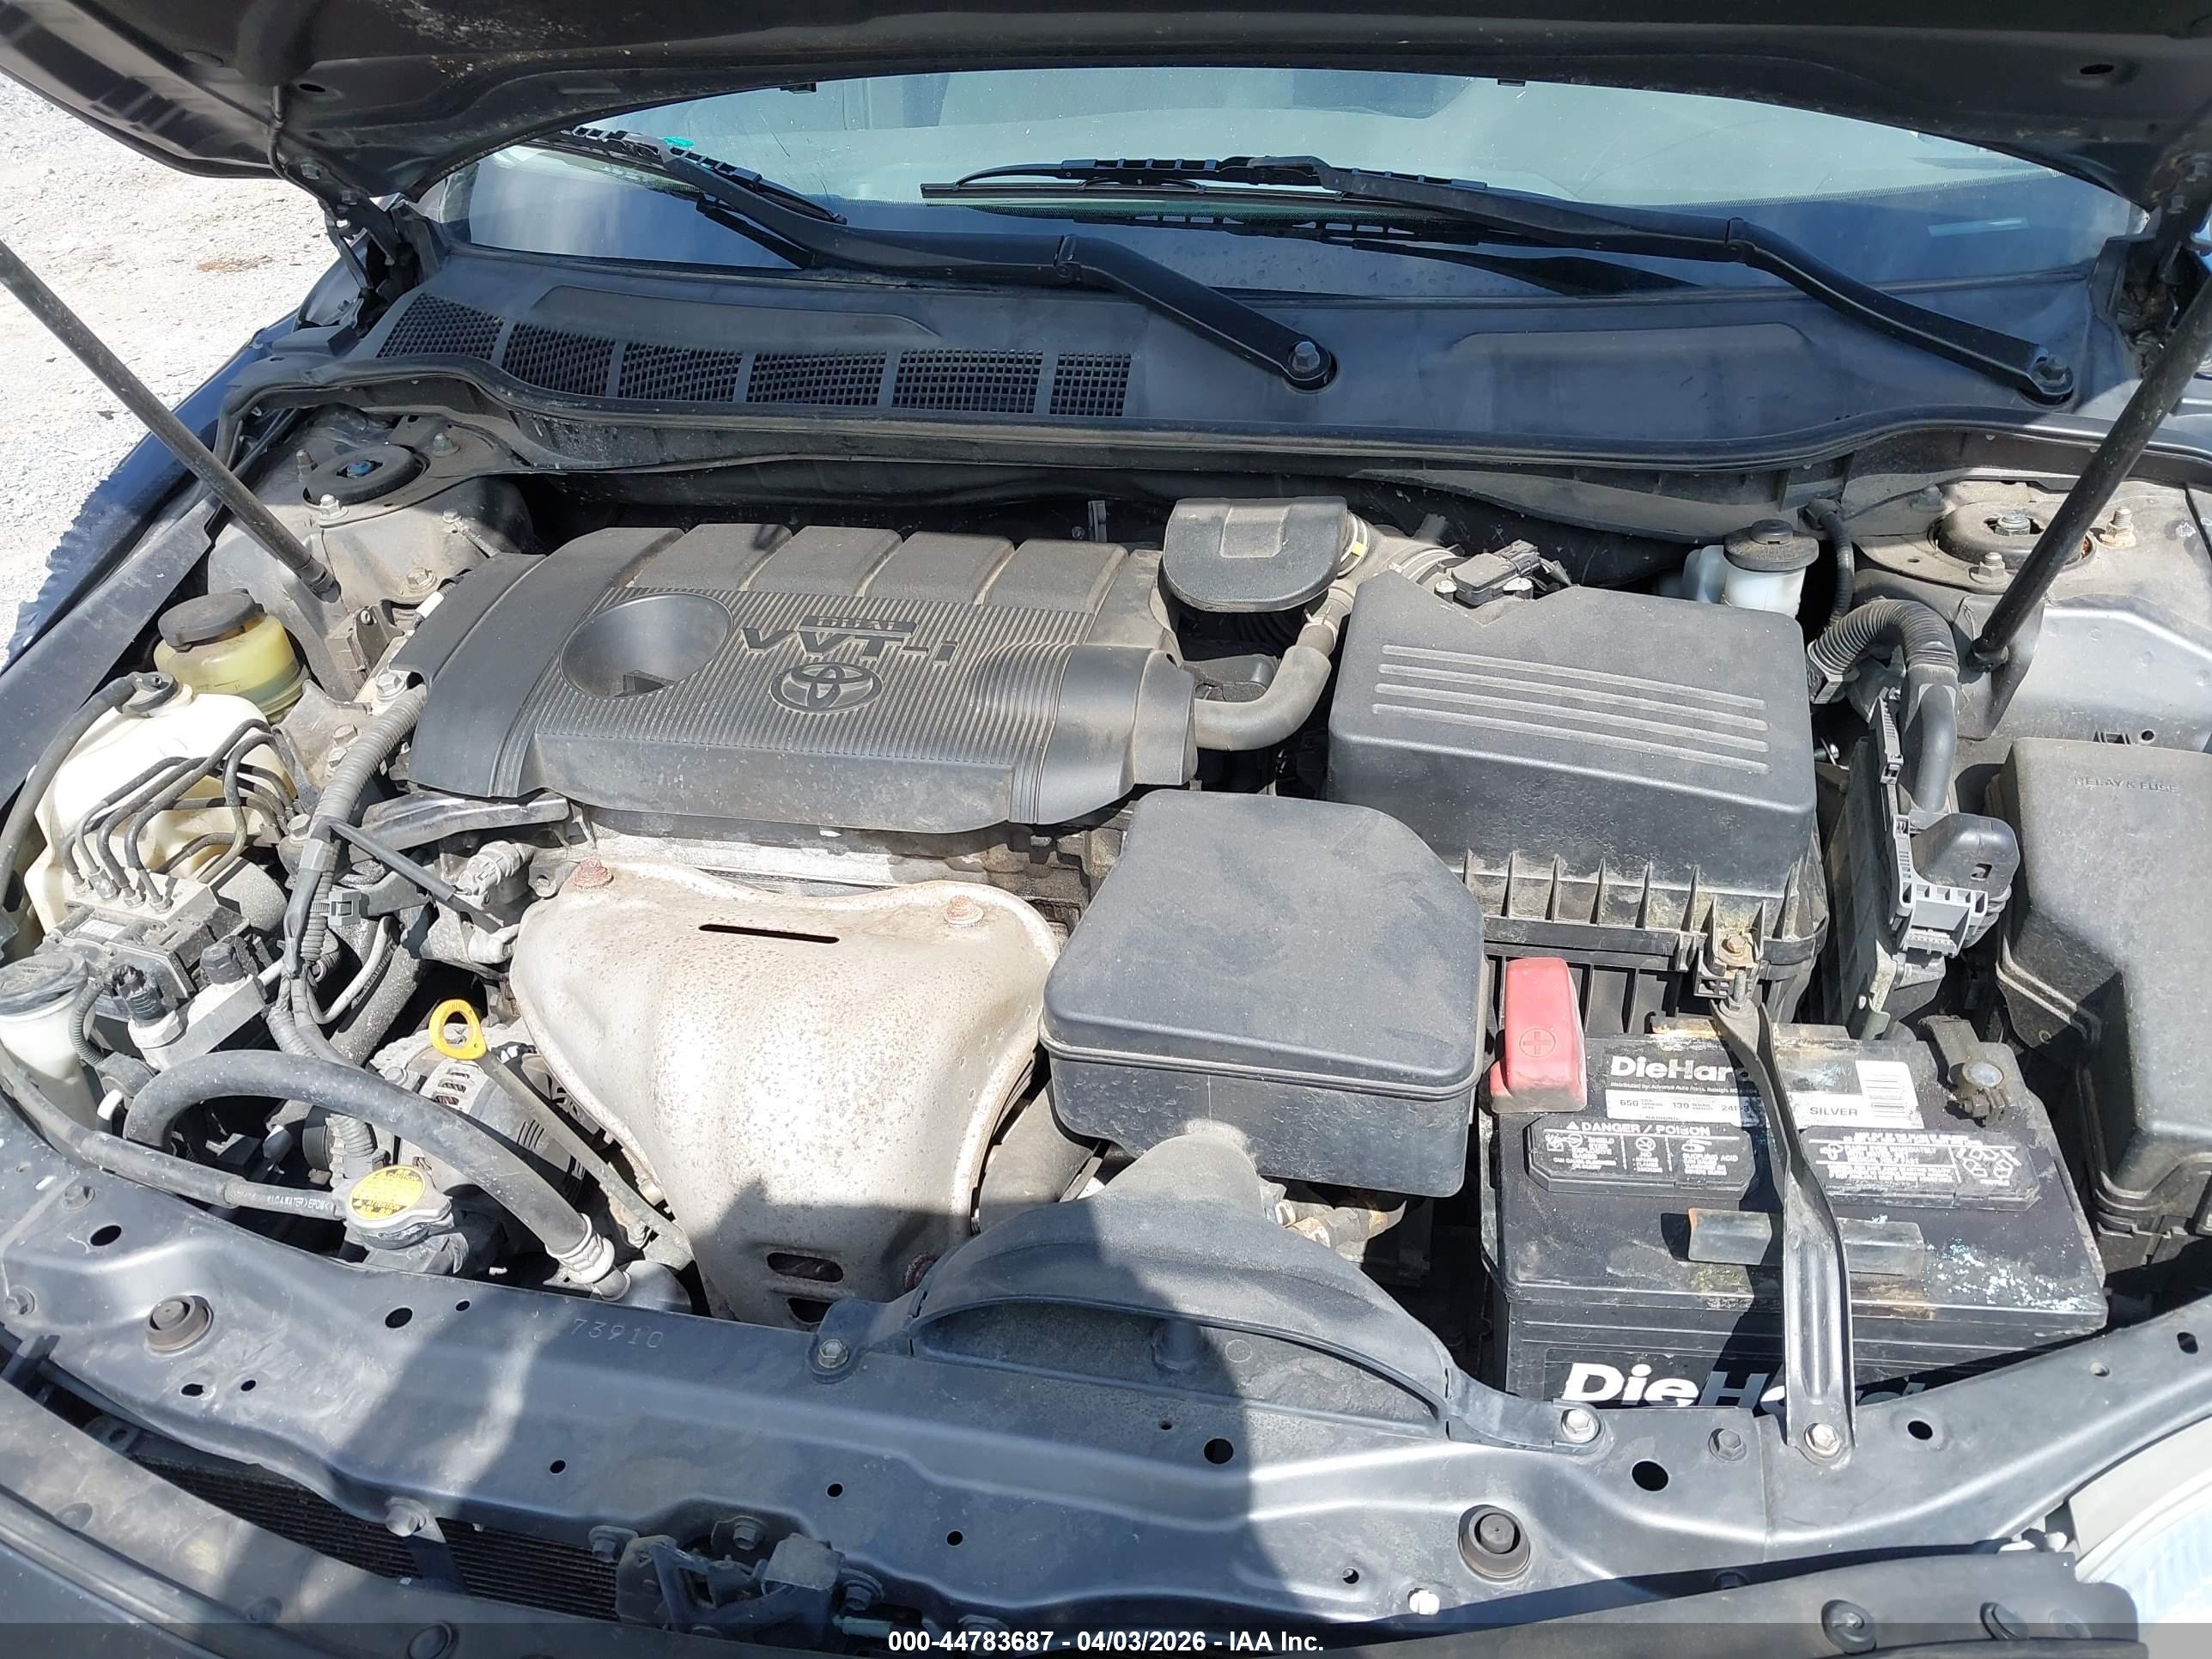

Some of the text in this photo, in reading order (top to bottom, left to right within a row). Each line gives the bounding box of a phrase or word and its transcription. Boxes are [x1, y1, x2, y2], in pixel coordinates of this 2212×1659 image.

[817, 617, 895, 631] DUAL
[742, 628, 958, 666] VVT-i
[2074, 776, 2123, 787] RELAY
[2140, 782, 2179, 793] FUSE
[1809, 1106, 1858, 1116] SILVER
[1581, 1121, 1641, 1133] DANGER
[1656, 1123, 1711, 1136] POISON
[366, 1200, 401, 1211] ATTENTION
[570, 1318, 664, 1348] 73910
